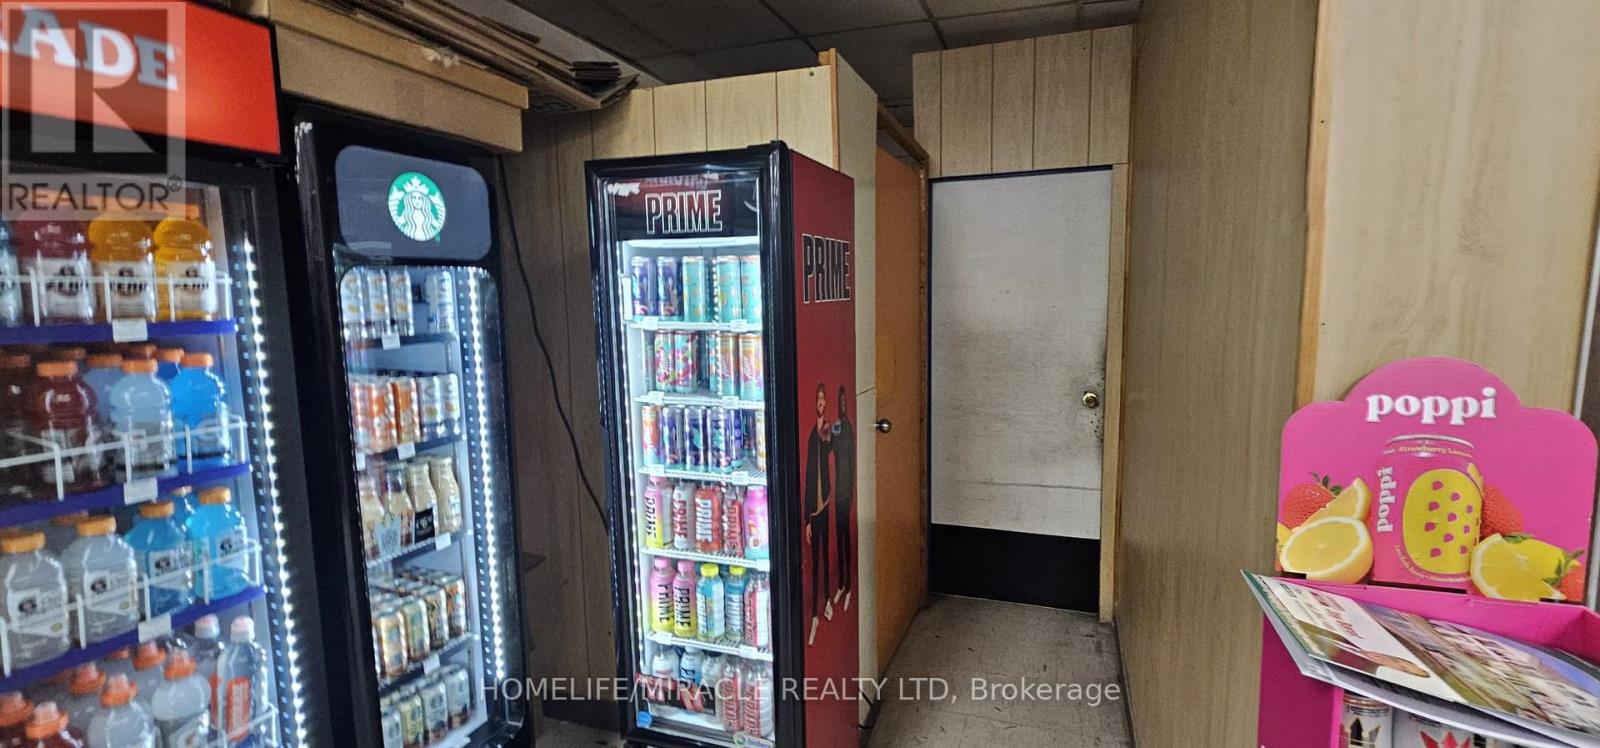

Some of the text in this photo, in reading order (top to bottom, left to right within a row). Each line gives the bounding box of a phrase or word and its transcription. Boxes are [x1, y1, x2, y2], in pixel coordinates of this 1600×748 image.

[0, 5, 178, 91] ADE
[645, 189, 722, 235] PRIME
[802, 233, 851, 304] PRIME
[1366, 387, 1497, 425] poppi
[695, 498, 713, 543] PRIME
[1376, 466, 1397, 533] poppi
[674, 586, 691, 627] PRIME
